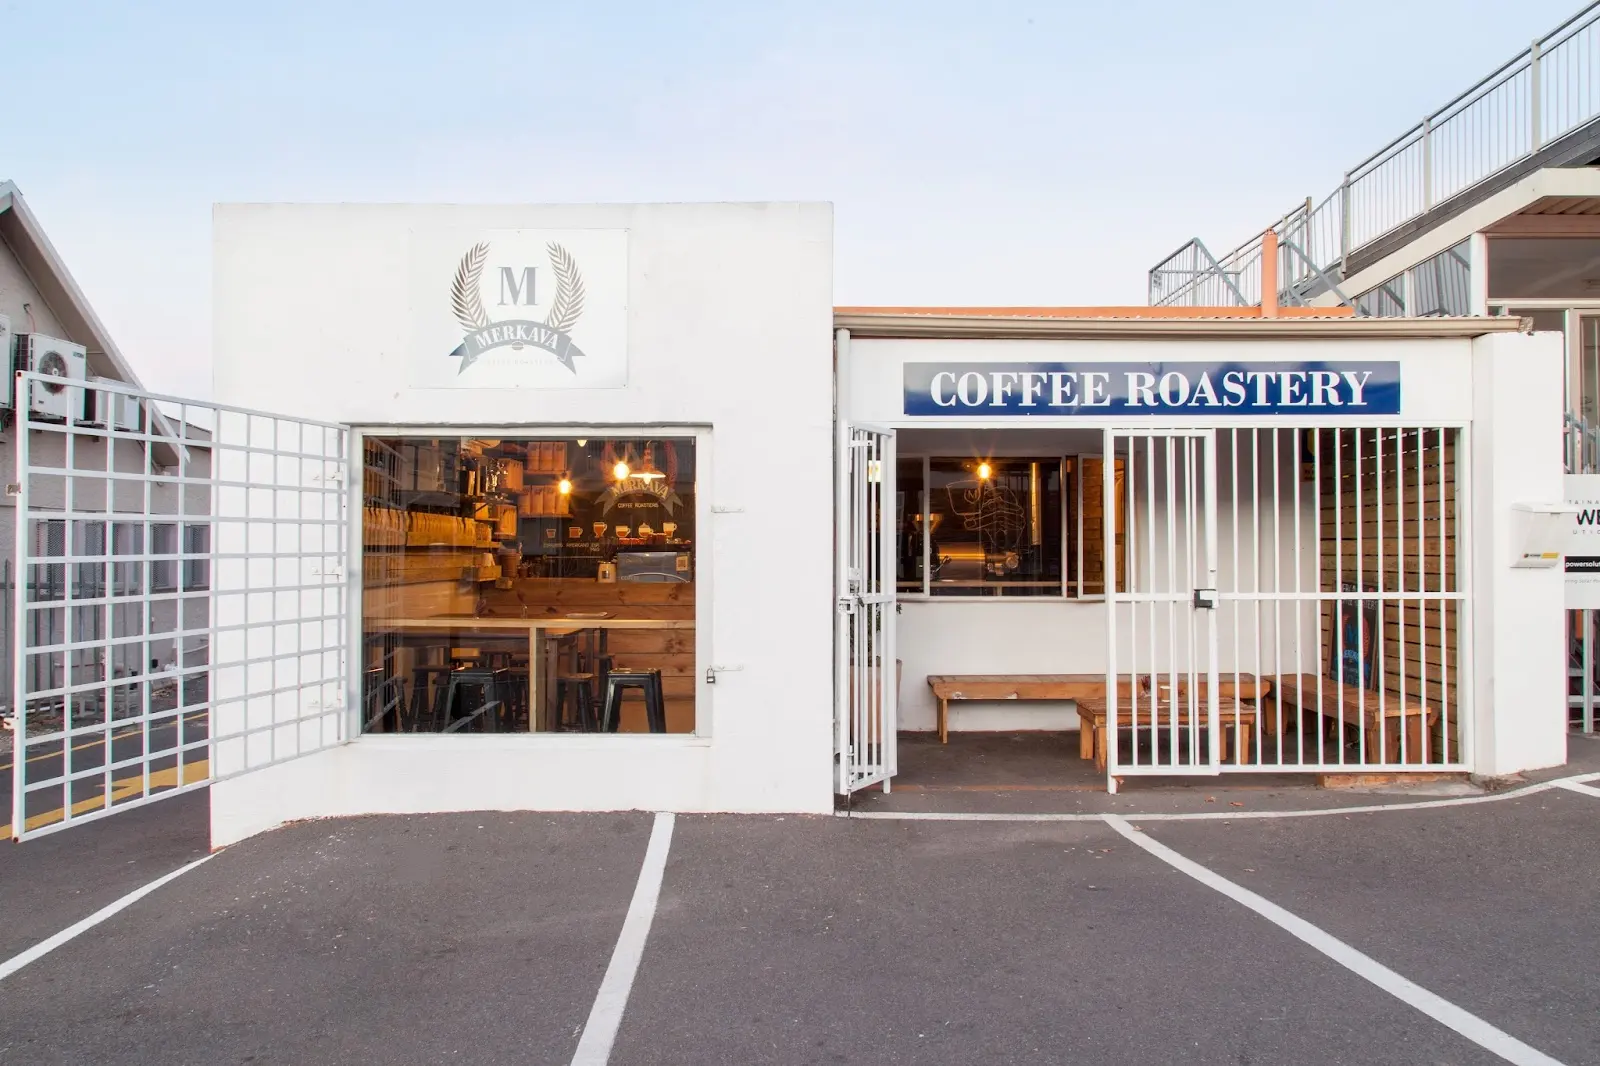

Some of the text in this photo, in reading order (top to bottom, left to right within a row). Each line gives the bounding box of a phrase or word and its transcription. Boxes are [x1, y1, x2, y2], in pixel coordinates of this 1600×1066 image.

[497, 266, 539, 306] M
[474, 325, 559, 349] MERKAVA
[930, 370, 1373, 408] COFFEE ROASTERY
